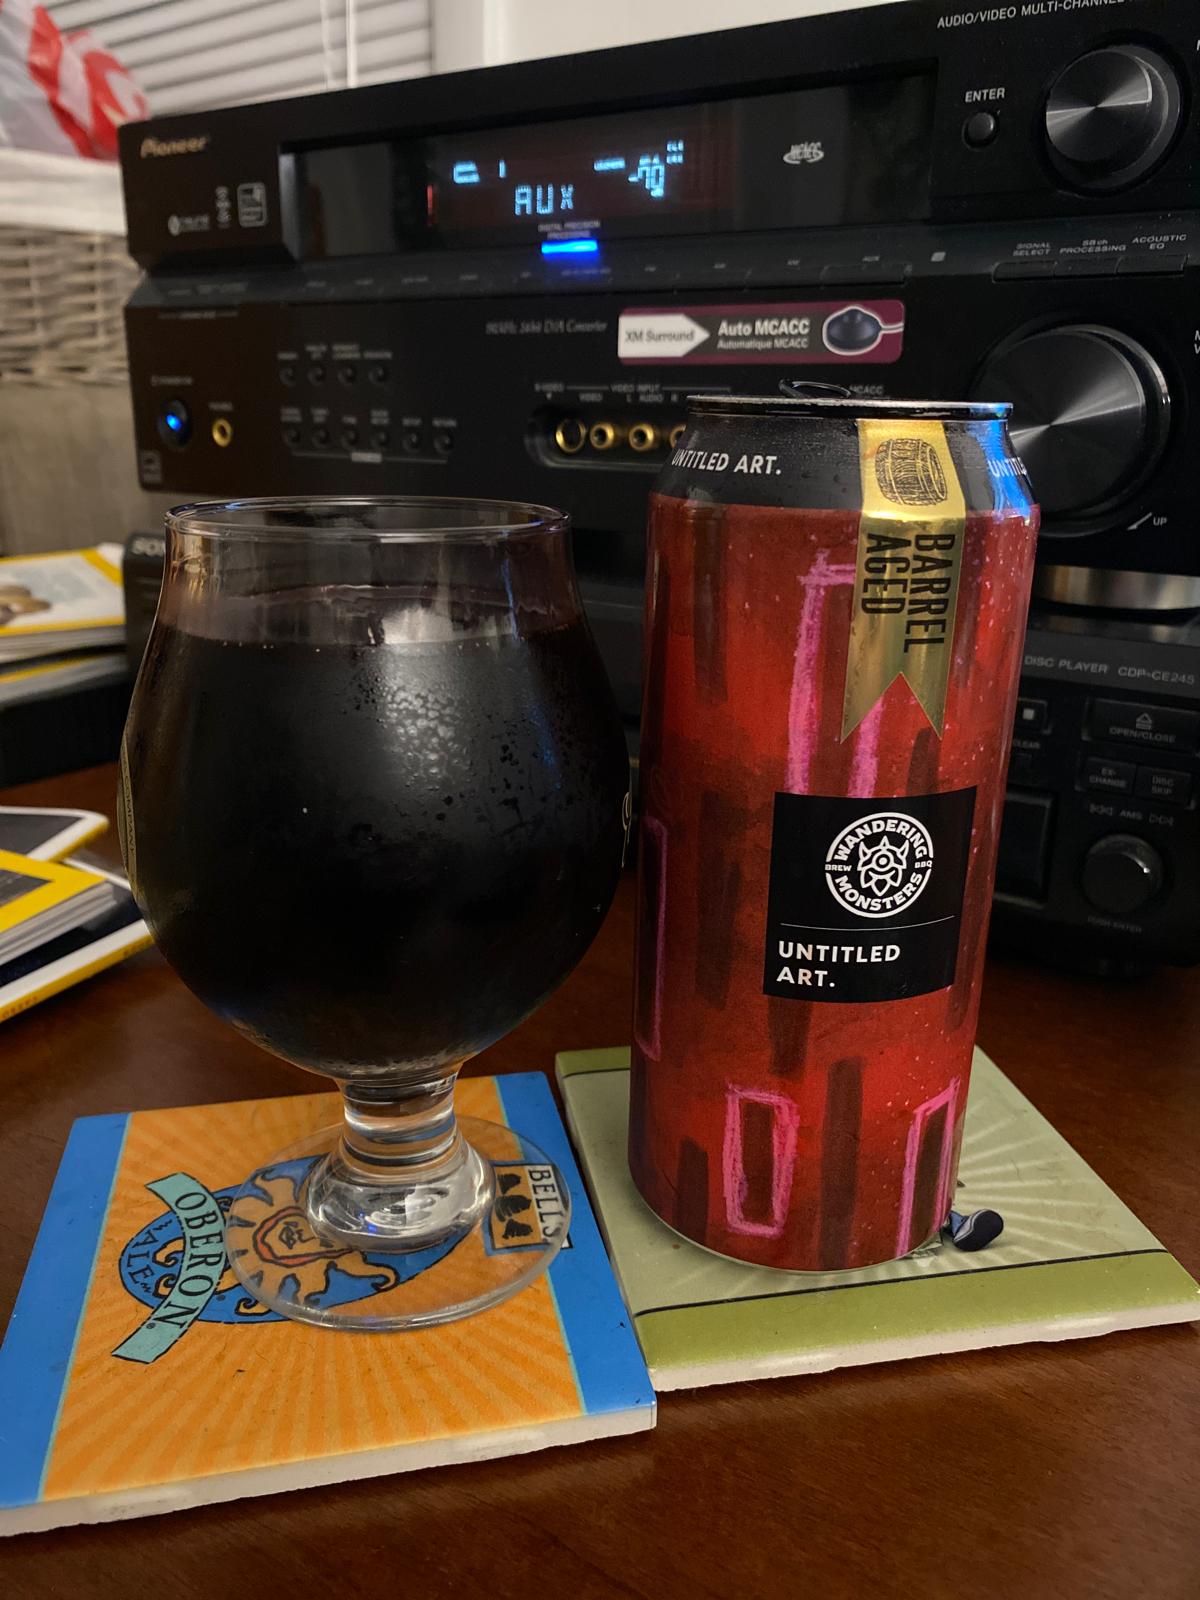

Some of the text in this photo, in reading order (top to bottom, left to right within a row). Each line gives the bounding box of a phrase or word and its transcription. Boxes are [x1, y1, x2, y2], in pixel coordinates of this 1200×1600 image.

[936, 0, 1124, 29] AUDIO/VIDEO MULTI-CHANN
[964, 87, 1006, 103] ENTER
[515, 184, 574, 216] AUX
[1059, 245, 1127, 254] PROCESSING
[1131, 233, 1188, 244] ACOUSTIC
[625, 330, 695, 343] XM Surround
[717, 318, 810, 337] Auto MCACC
[717, 338, 808, 351] Automatique MCACC
[671, 448, 781, 475] UNTITLED ART.
[1152, 516, 1168, 527] UP
[860, 532, 912, 615] AGED
[903, 532, 956, 653] BARREL
[1024, 656, 1055, 668] DISC
[1058, 658, 1109, 674] PLAYER
[1109, 726, 1177, 743] OPEN/CLOSE
[833, 818, 928, 862] WANDERING
[824, 863, 852, 873] BREW
[834, 871, 923, 912] MONSTERS
[778, 940, 901, 963] UNTITLED
[776, 966, 836, 988] ART.
[126, 1230, 160, 1284] ALE
[153, 1191, 227, 1329] OBERON
